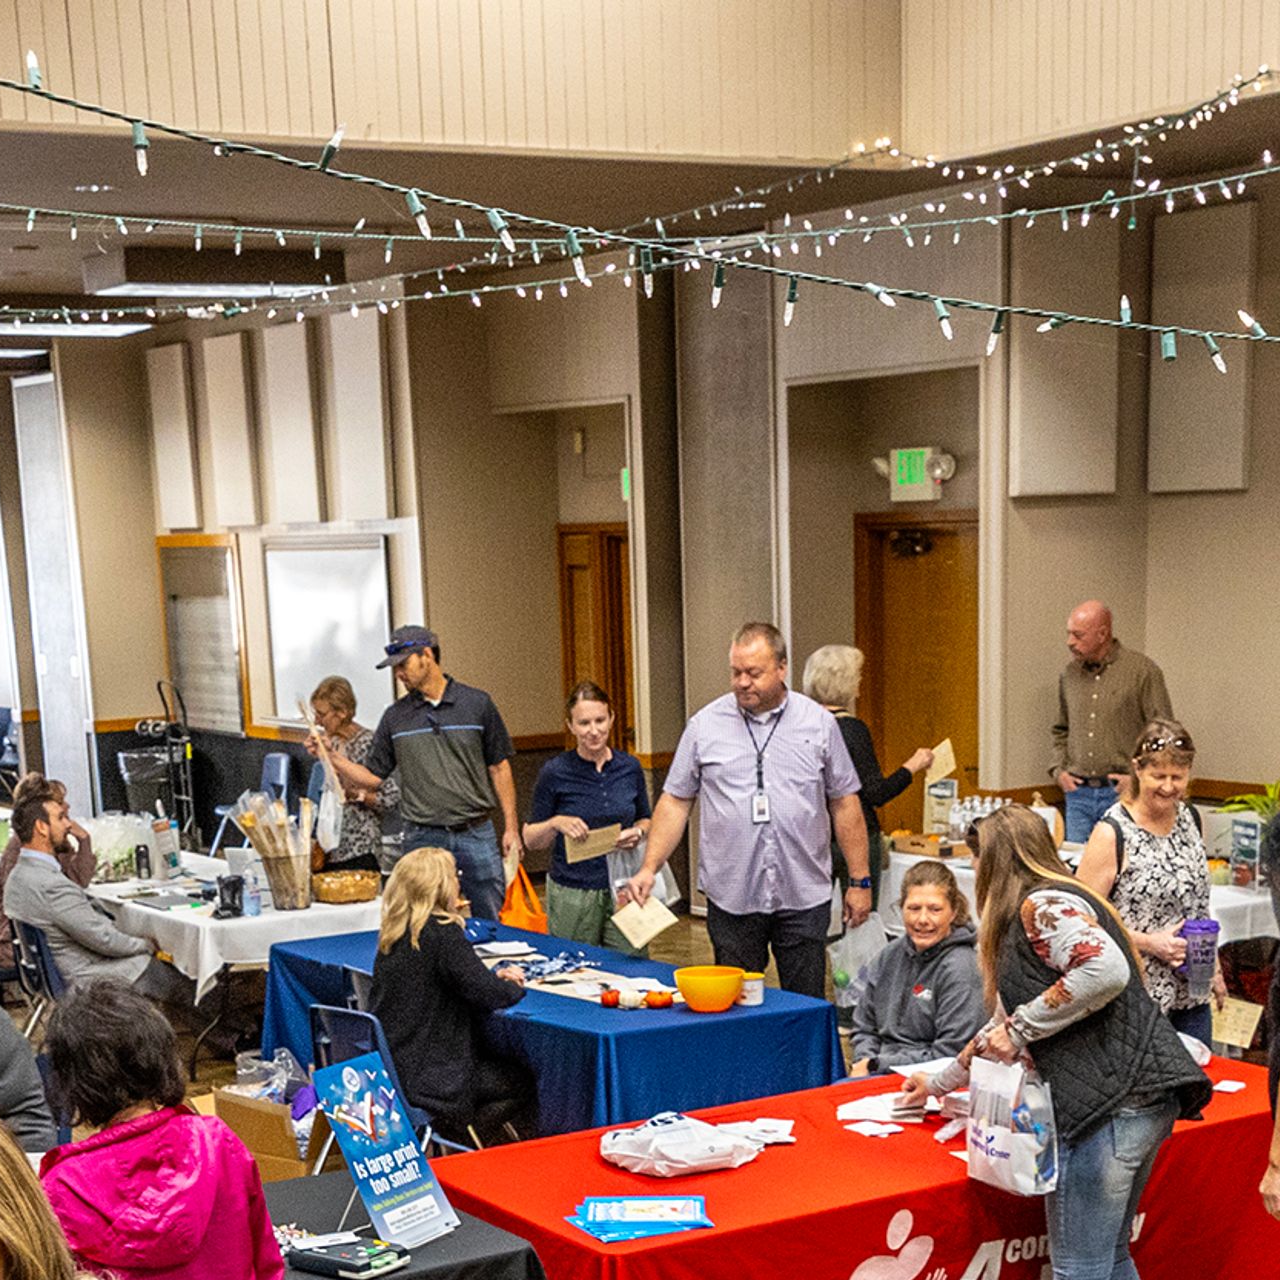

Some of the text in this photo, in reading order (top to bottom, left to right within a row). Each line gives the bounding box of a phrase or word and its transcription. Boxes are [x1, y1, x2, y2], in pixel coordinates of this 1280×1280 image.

[353, 1140, 420, 1179] Is large print
[370, 1160, 422, 1195] too small?
